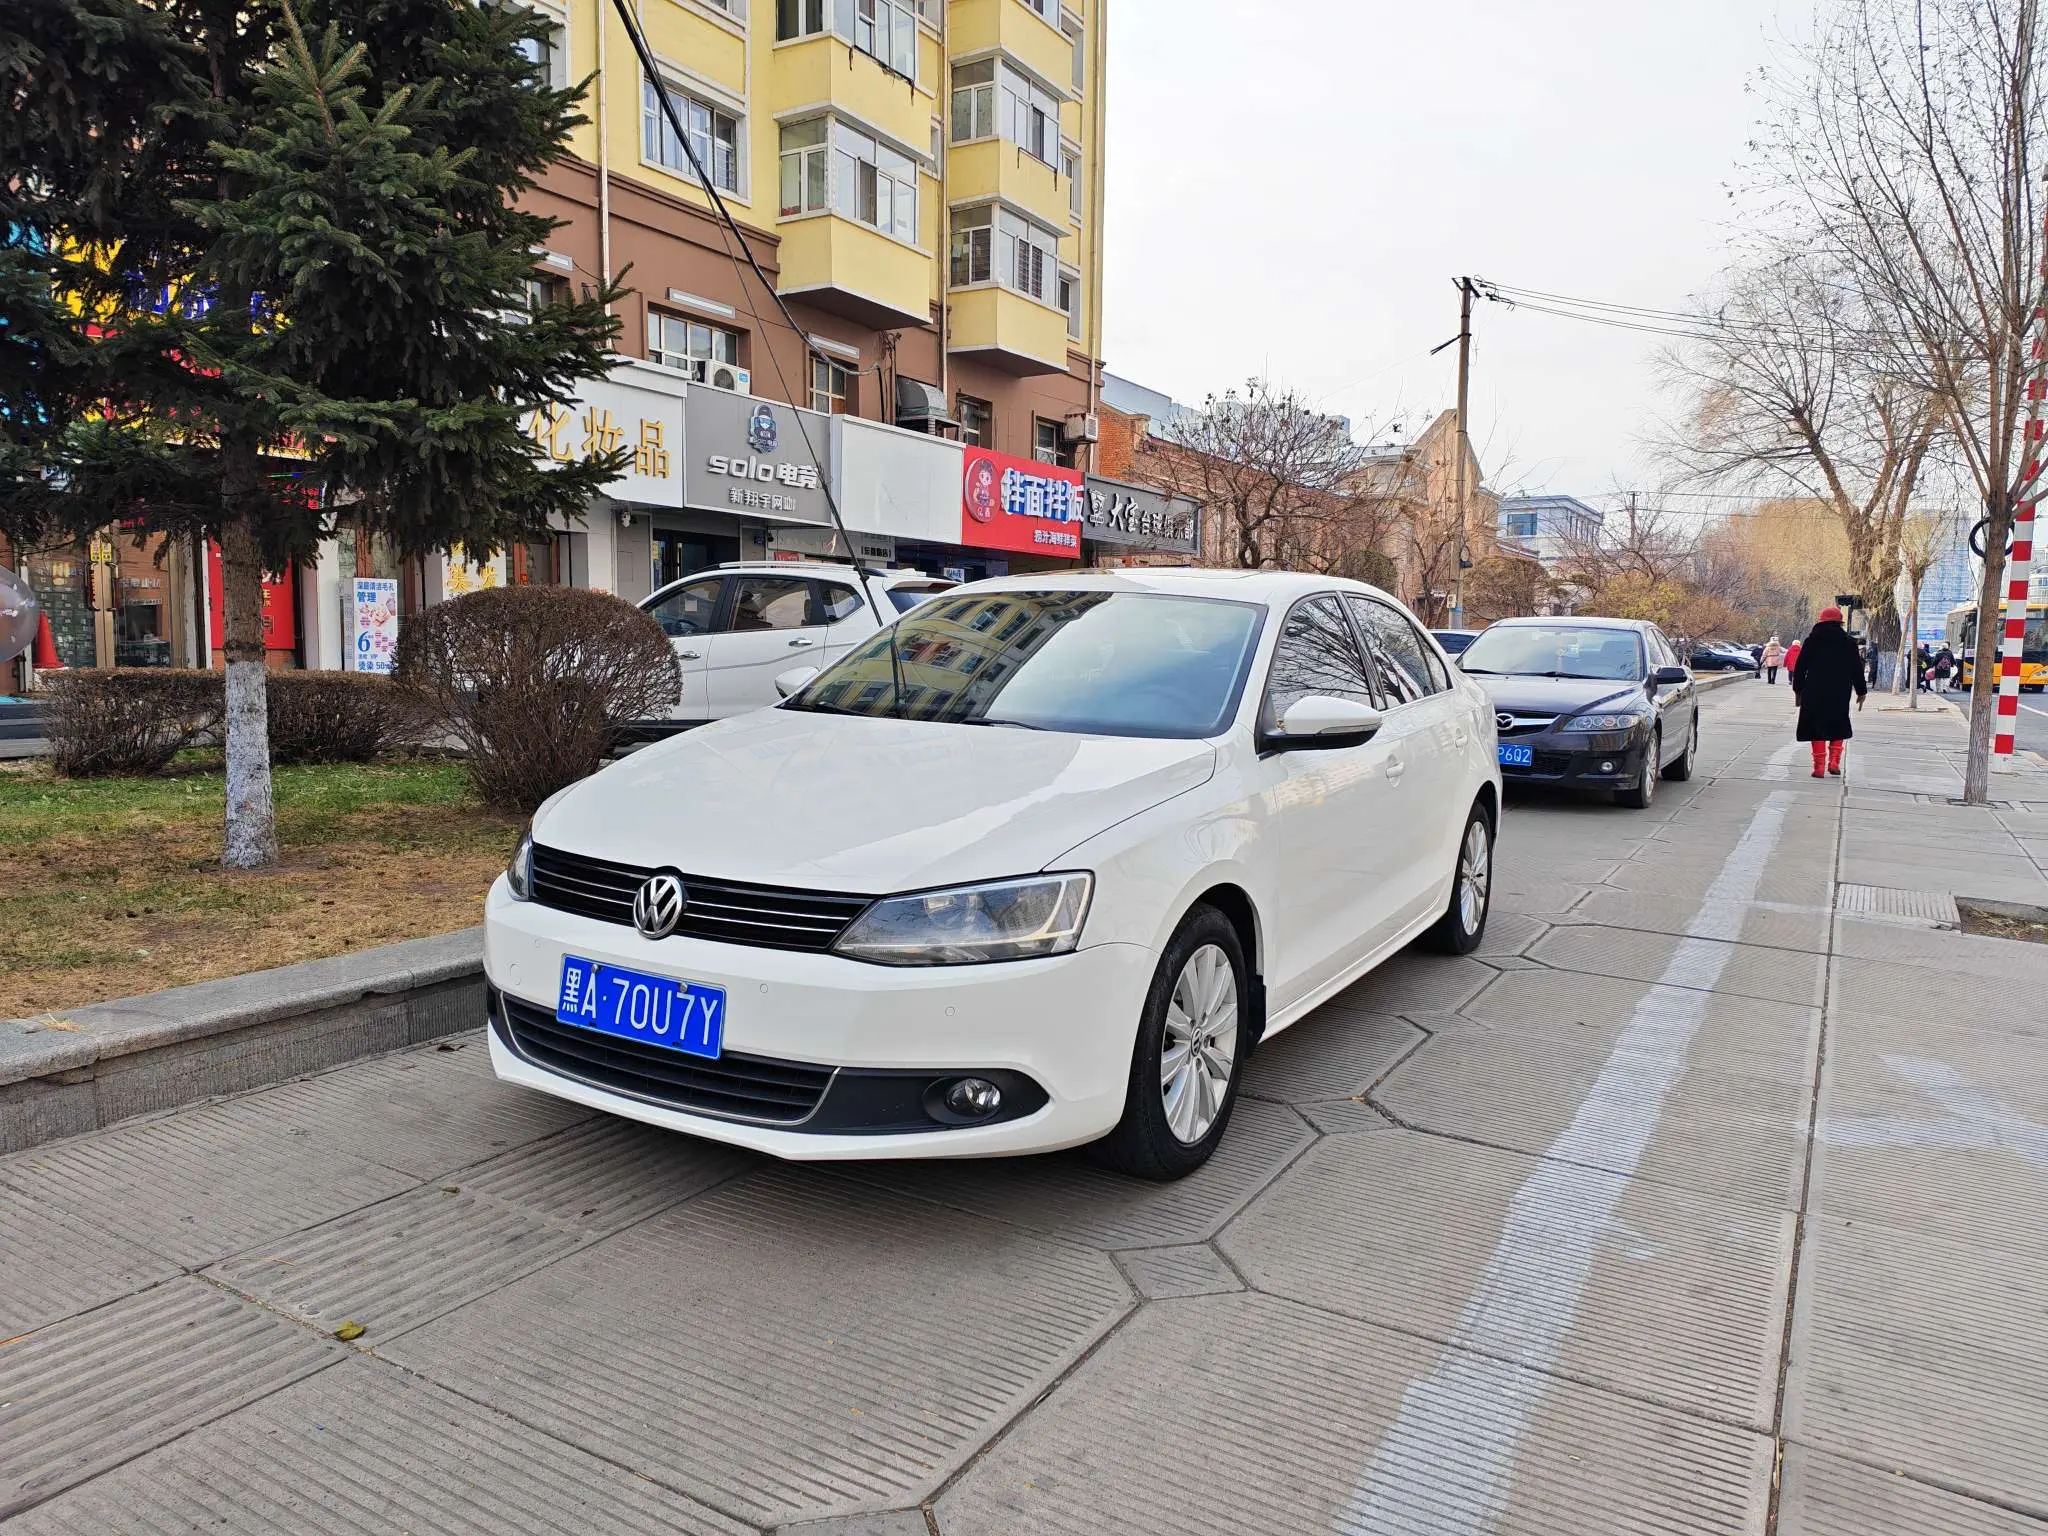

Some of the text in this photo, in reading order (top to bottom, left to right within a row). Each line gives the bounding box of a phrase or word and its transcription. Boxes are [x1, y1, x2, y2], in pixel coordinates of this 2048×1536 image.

[528, 399, 672, 480] 化妆品
[707, 455, 819, 490] solo 电竞
[1000, 467, 1084, 524] 拌面拌饭
[356, 591, 377, 603] 管理
[357, 630, 371, 652] 6
